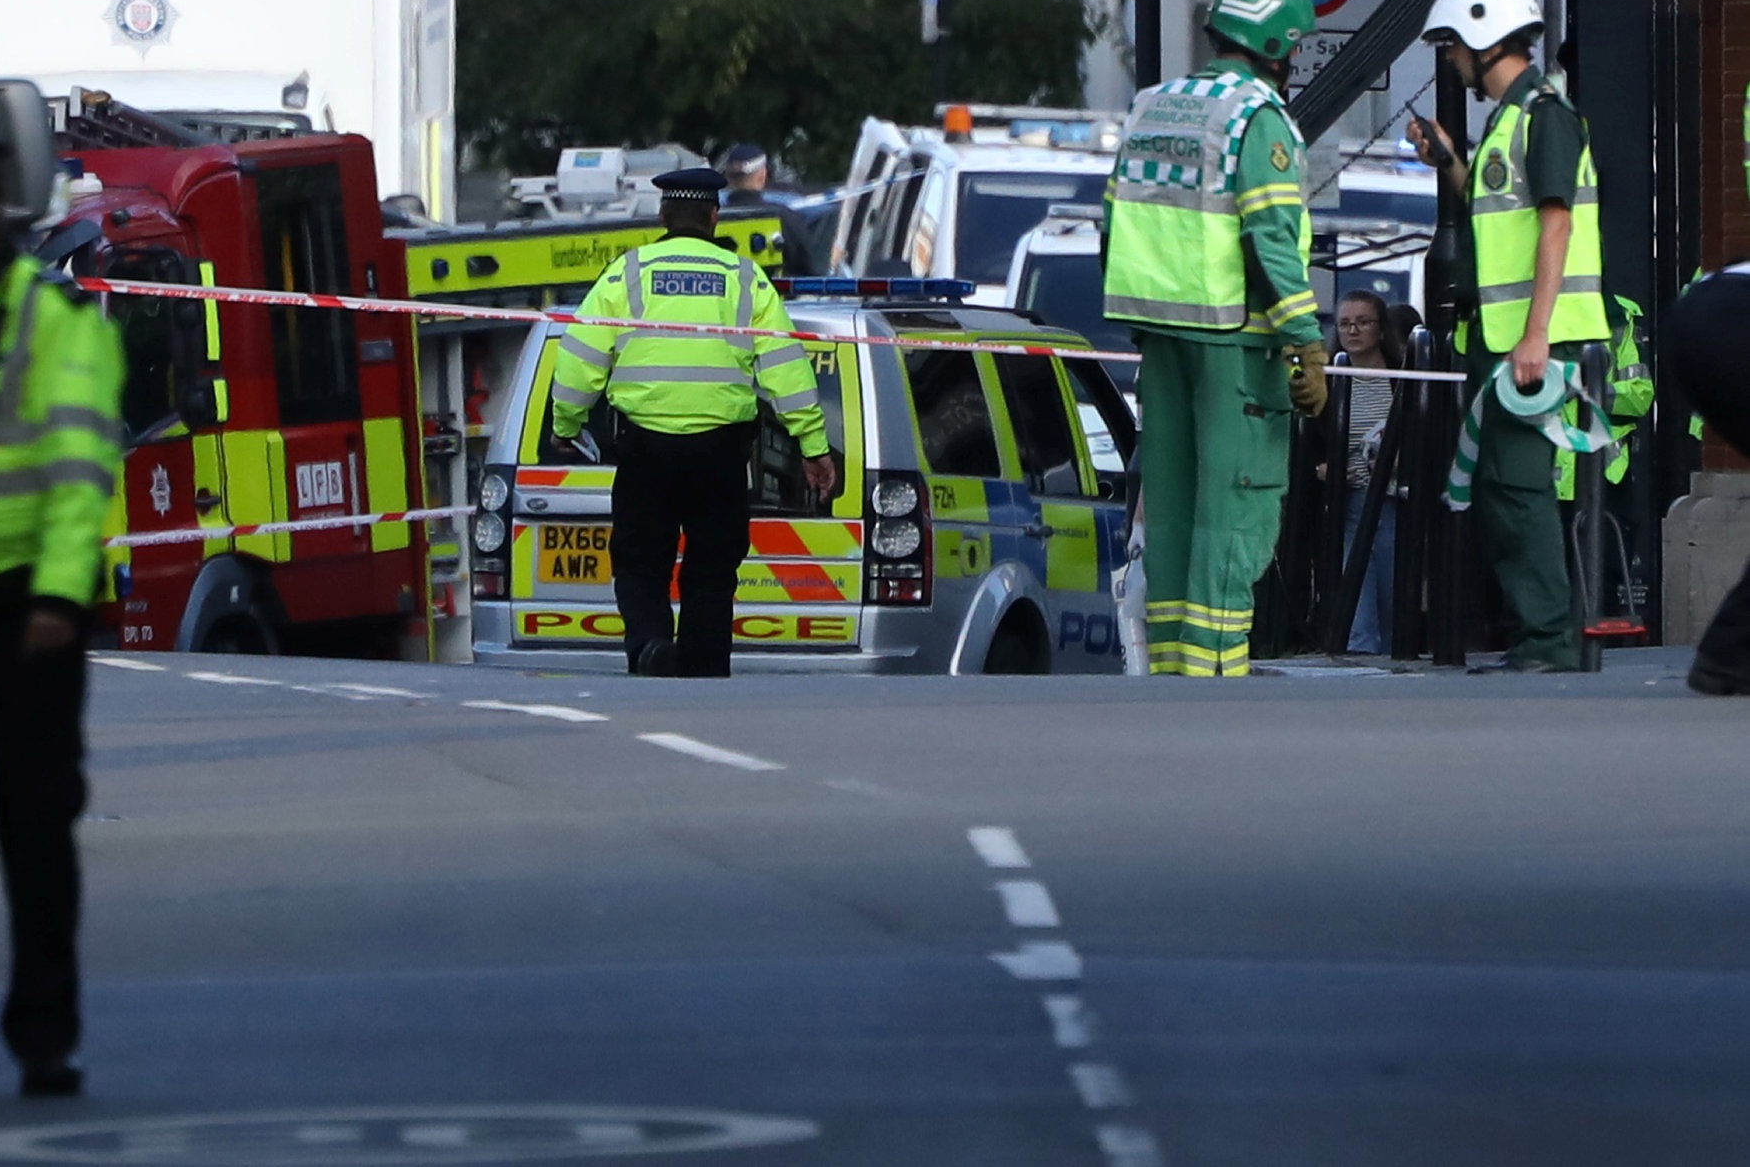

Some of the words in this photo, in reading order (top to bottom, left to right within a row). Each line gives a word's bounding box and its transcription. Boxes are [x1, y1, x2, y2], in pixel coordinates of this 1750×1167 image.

[1128, 134, 1201, 159] SECTOR
[653, 272, 725, 282] METROPOLITAN
[653, 279, 725, 296] POLICE
[543, 525, 607, 551] BX66
[552, 554, 598, 579] AWR
